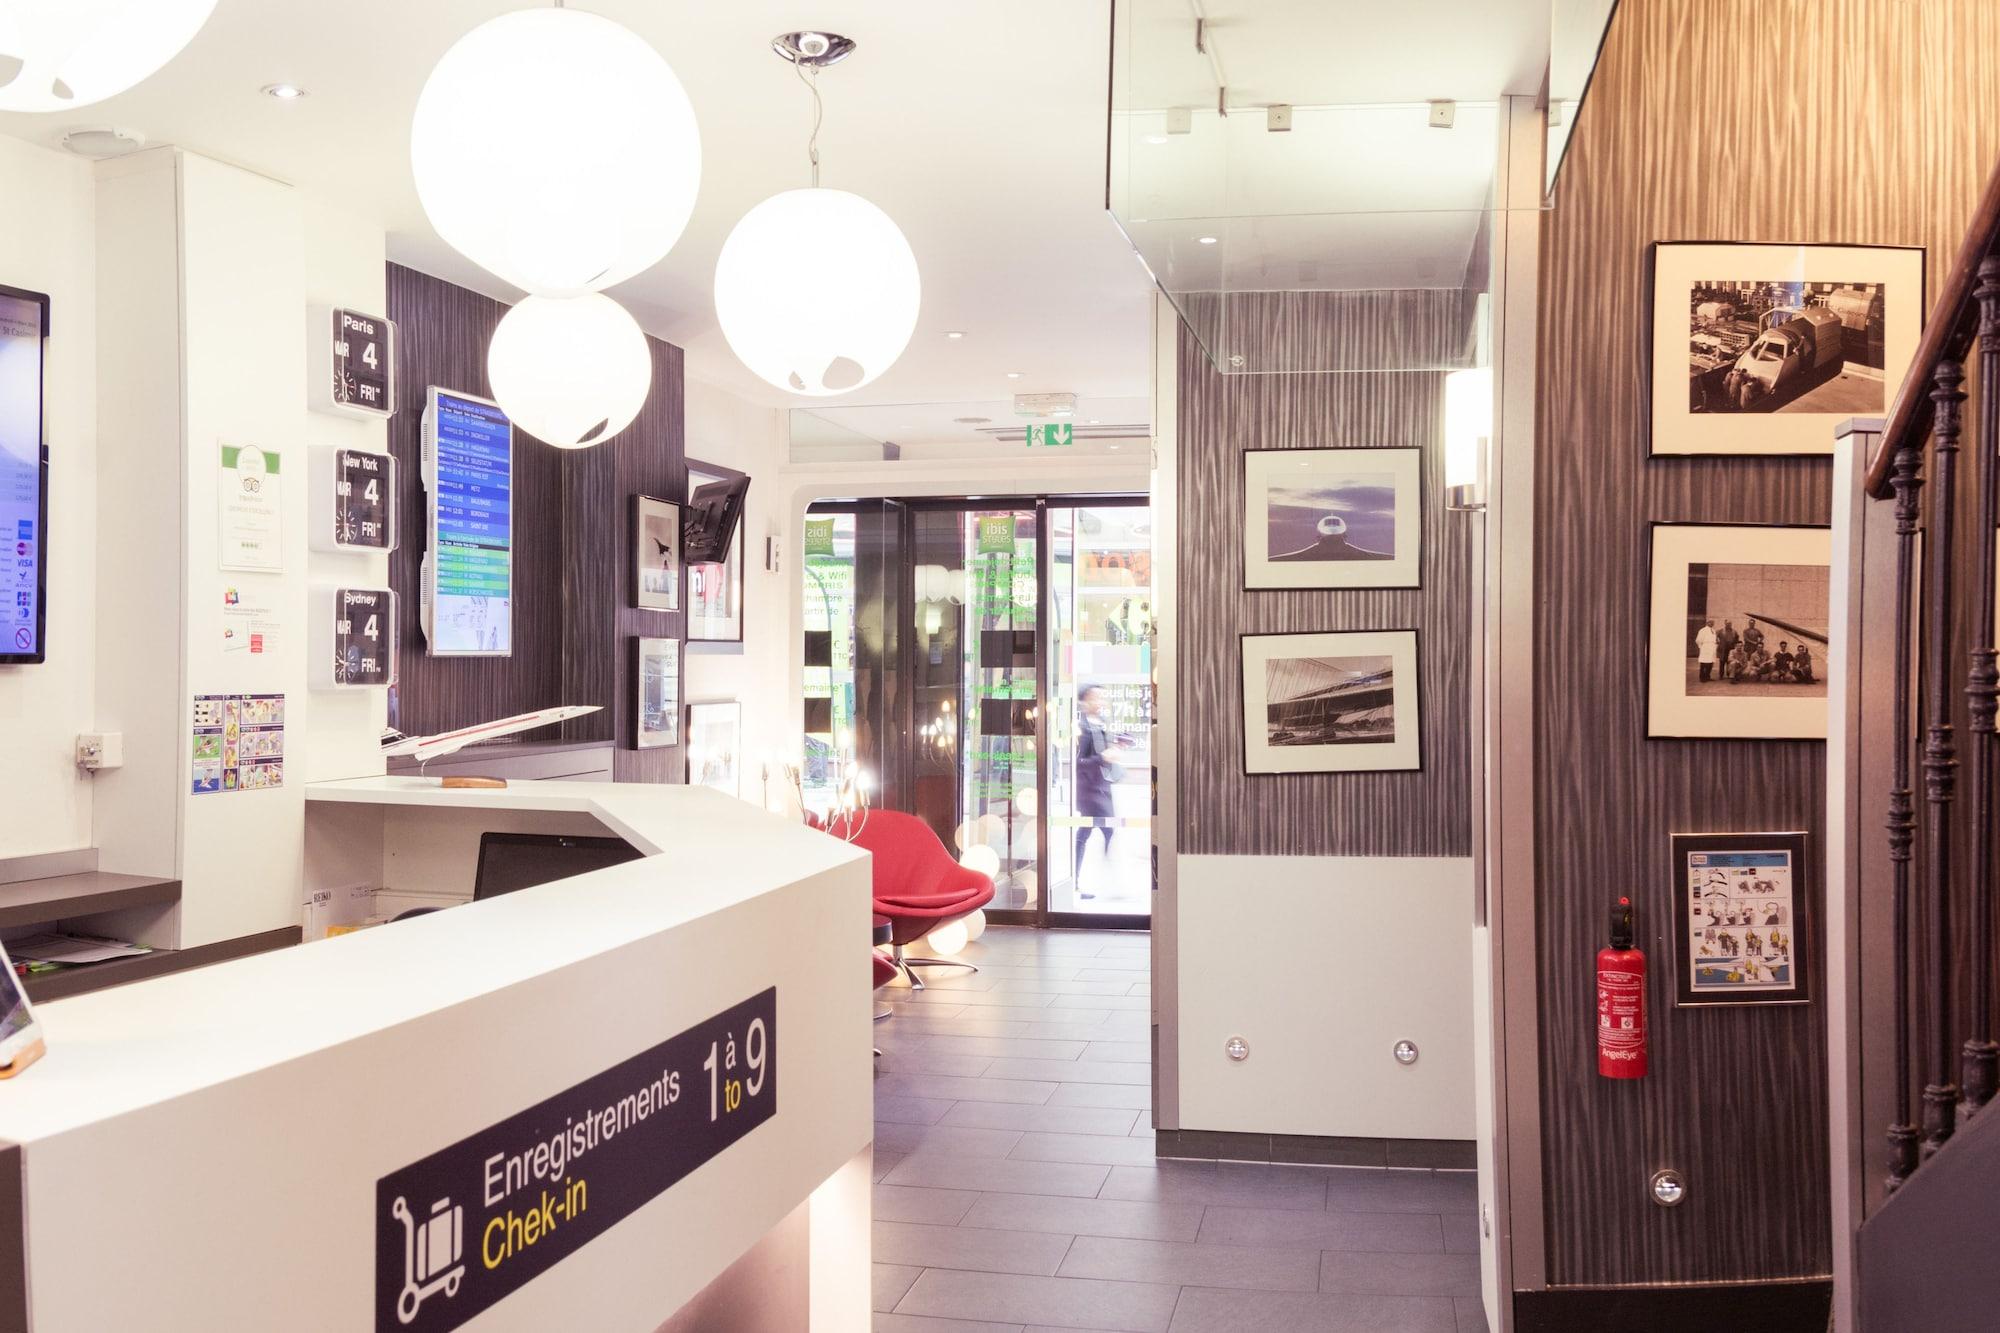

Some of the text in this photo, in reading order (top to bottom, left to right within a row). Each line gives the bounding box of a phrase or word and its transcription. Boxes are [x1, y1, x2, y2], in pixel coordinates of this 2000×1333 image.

[344, 315, 374, 335] Paris
[363, 342, 378, 370] 4
[360, 384, 375, 401] FRI
[343, 455, 378, 471] New York
[364, 479, 379, 506] 4
[362, 521, 377, 537] FRI
[987, 523, 1008, 535] ibis
[18, 559, 32, 567] VISA
[829, 571, 847, 580] Wifi
[344, 592, 377, 607] Sydney
[364, 614, 379, 642] 4
[361, 658, 376, 673] FRI
[1602, 1047, 1638, 1061] AngelEye
[724, 1077, 742, 1113] to
[484, 1017, 767, 1208] Enregistrements 1 à 9
[482, 1178, 587, 1270] Chek-in
